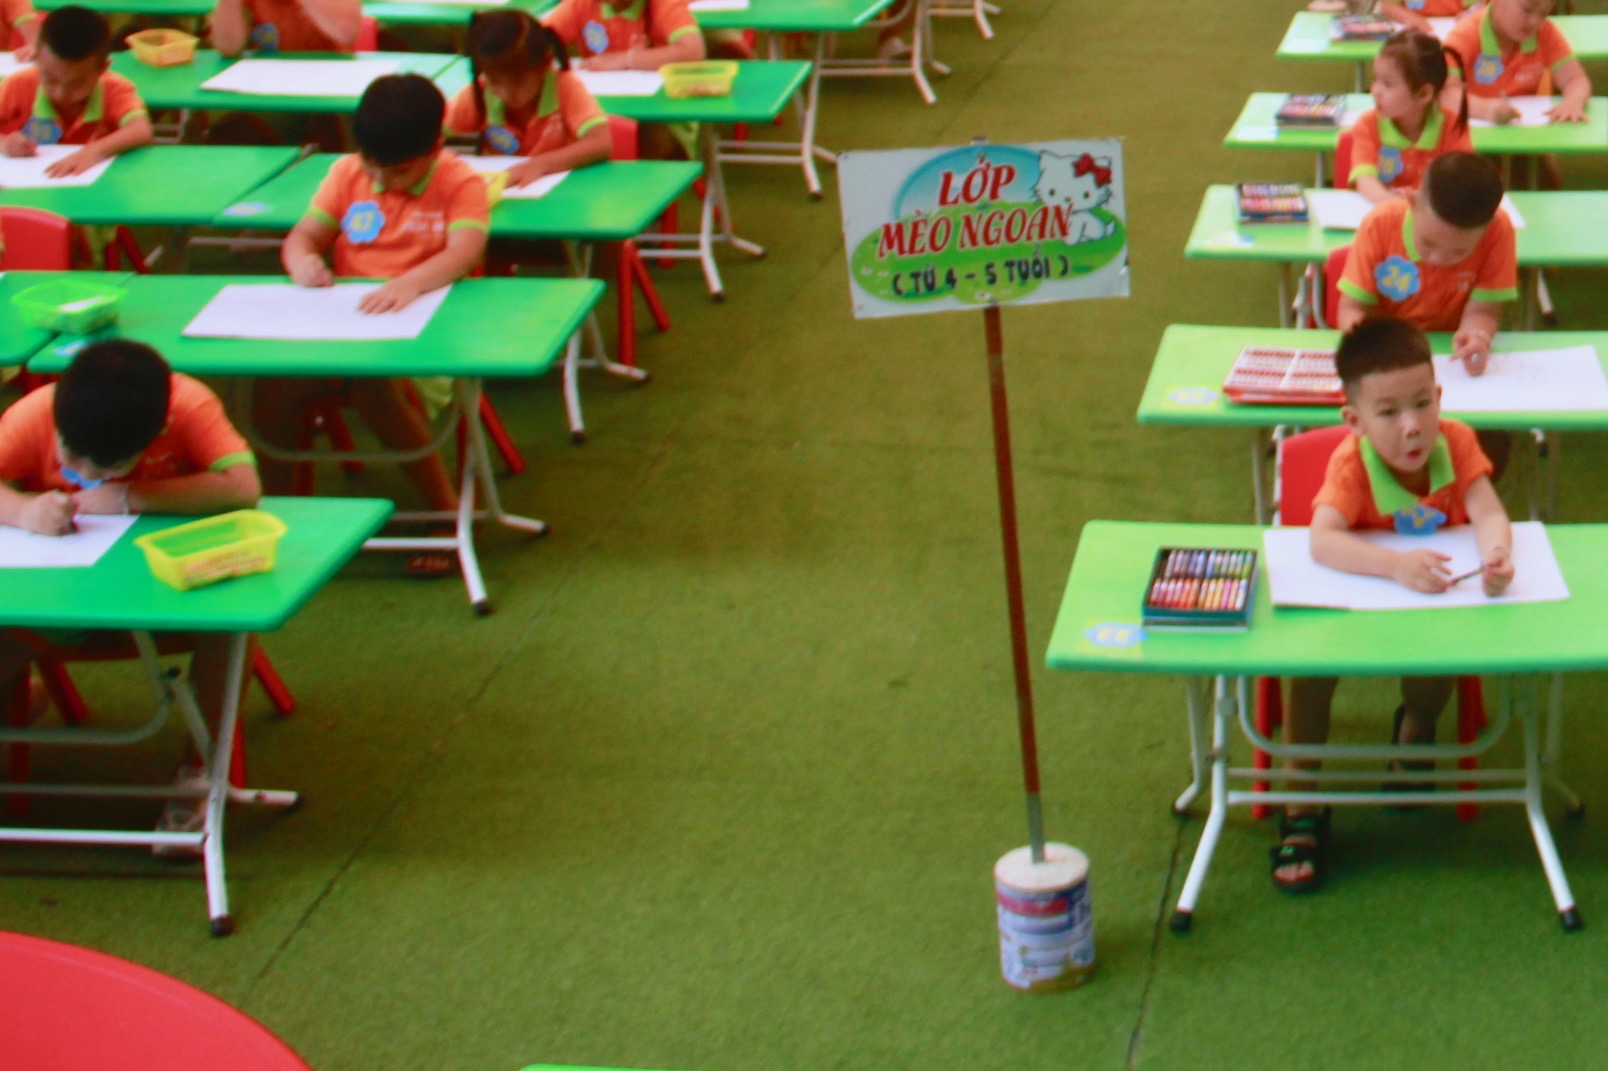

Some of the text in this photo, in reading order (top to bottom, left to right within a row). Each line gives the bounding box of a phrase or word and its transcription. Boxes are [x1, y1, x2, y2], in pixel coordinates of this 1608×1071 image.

[938, 151, 1017, 208] LỚP
[878, 203, 1075, 259] MÈO NGOAN
[1381, 264, 1411, 293] 24
